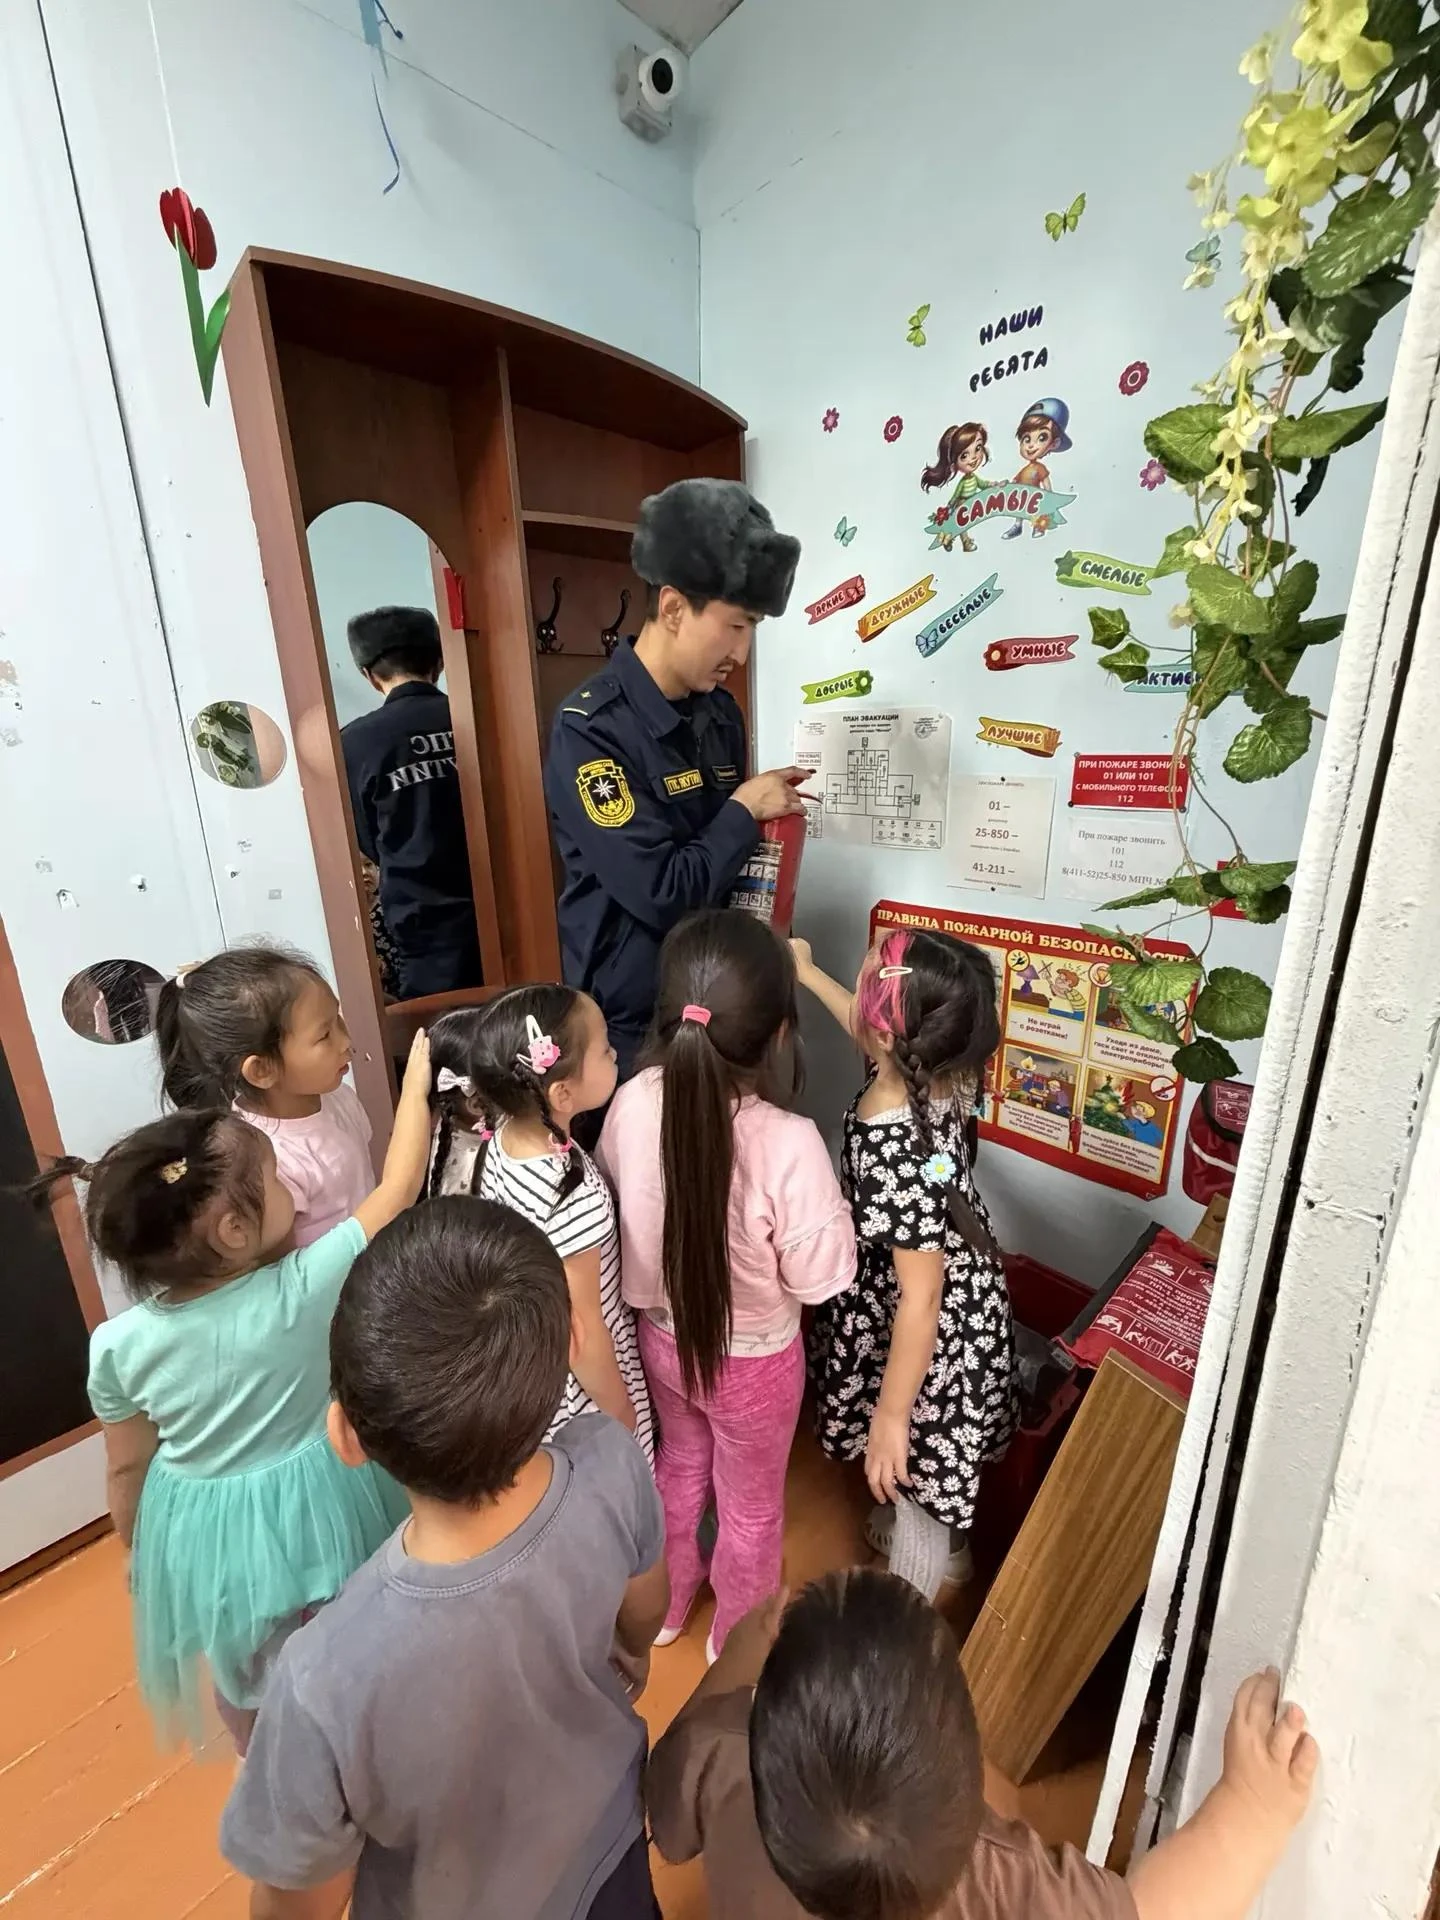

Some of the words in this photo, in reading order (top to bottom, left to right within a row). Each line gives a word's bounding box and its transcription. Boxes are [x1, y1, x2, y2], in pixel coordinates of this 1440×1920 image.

[980, 305, 1043, 346] НАШИ
[970, 347, 1048, 392] РЕБЯТА
[957, 489, 1043, 526] САМЫЕ
[1081, 560, 1146, 587] СМЕЛЫЕ
[815, 591, 845, 616] ЯРКИЕ
[871, 586, 925, 626] ДРУЖНЫЕ
[1012, 643, 1066, 659] УМНЫЕ
[816, 678, 854, 697] ДОБРЫЕ
[860, 714, 899, 722] ЭВАКУАЦИИ
[988, 726, 1043, 744] ЛУЧШИЕ
[1079, 760, 1097, 768] ПРИ
[1099, 760, 1138, 769] ПОЖАРЕ
[1116, 772, 1136, 780] ИЛИ
[1139, 772, 1154, 780] 101
[1082, 784, 1136, 792] МОБИЛЬНОГО
[989, 801, 1001, 810] 01
[975, 828, 1010, 839] 25-850
[1078, 830, 1095, 840] При
[1097, 834, 1128, 843] пожаре
[1130, 836, 1166, 845] звонить
[1111, 847, 1125, 855] 101
[973, 862, 1006, 874] 41-211
[1110, 860, 1124, 869] 112
[1062, 867, 1127, 881] 8(411-52)25-850
[877, 909, 940, 929] ПРАВИЛА
[944, 920, 1034, 945] ПОЖАРНОЙ
[1028, 1017, 1038, 1026] Не
[1040, 1020, 1061, 1031] играй
[1026, 1025, 1068, 1040] розетками!
[1101, 1049, 1164, 1069] электроприборы!
